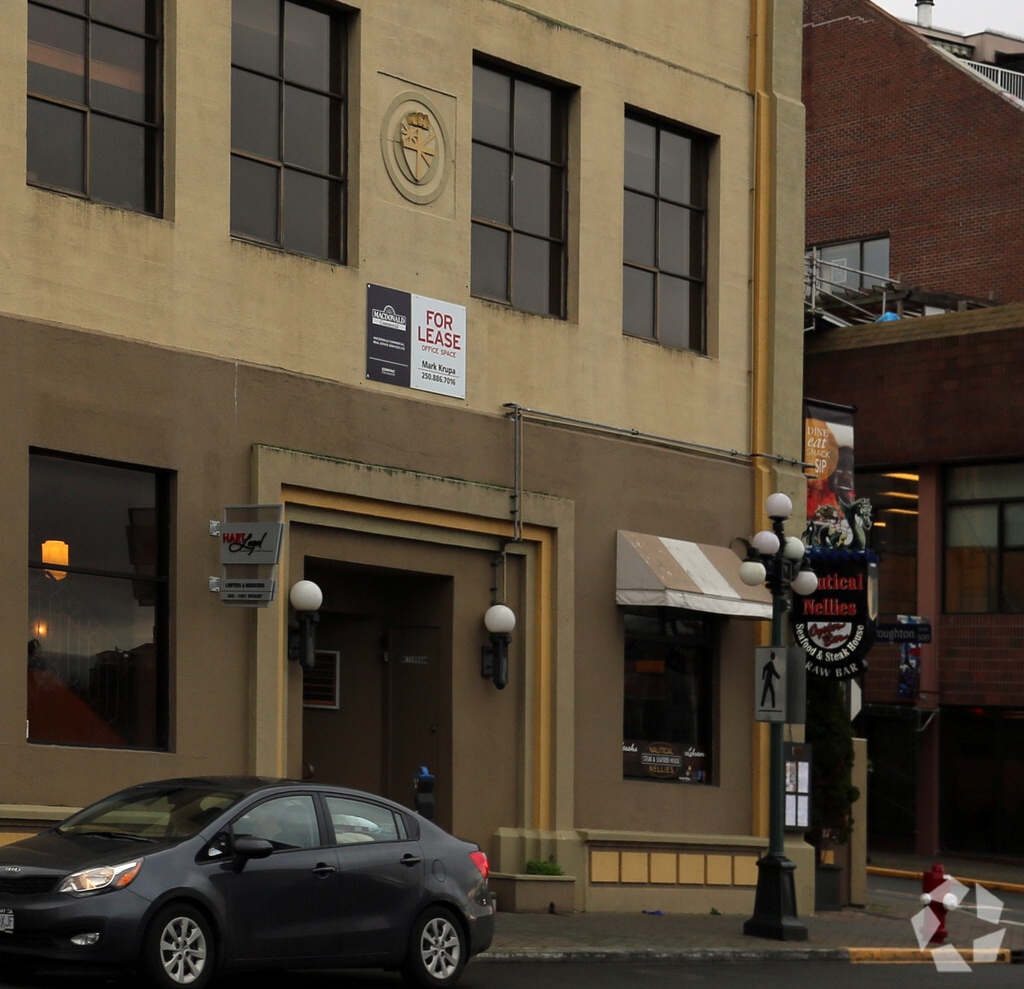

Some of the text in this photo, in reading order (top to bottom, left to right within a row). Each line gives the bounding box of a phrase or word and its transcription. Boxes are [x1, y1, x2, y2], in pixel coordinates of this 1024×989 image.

[426, 310, 453, 330] FOR
[418, 326, 461, 350] LEASE
[422, 345, 456, 358] OFFICE SPACE
[421, 360, 456, 375] Mark Krupa
[807, 437, 827, 449] eat
[815, 458, 827, 474] SIP
[222, 532, 246, 543] HART
[228, 531, 267, 556] Legal
[803, 598, 857, 616] Nellies
[796, 623, 865, 662] Seafood & Steak House
[805, 660, 859, 678] RAW BAR
